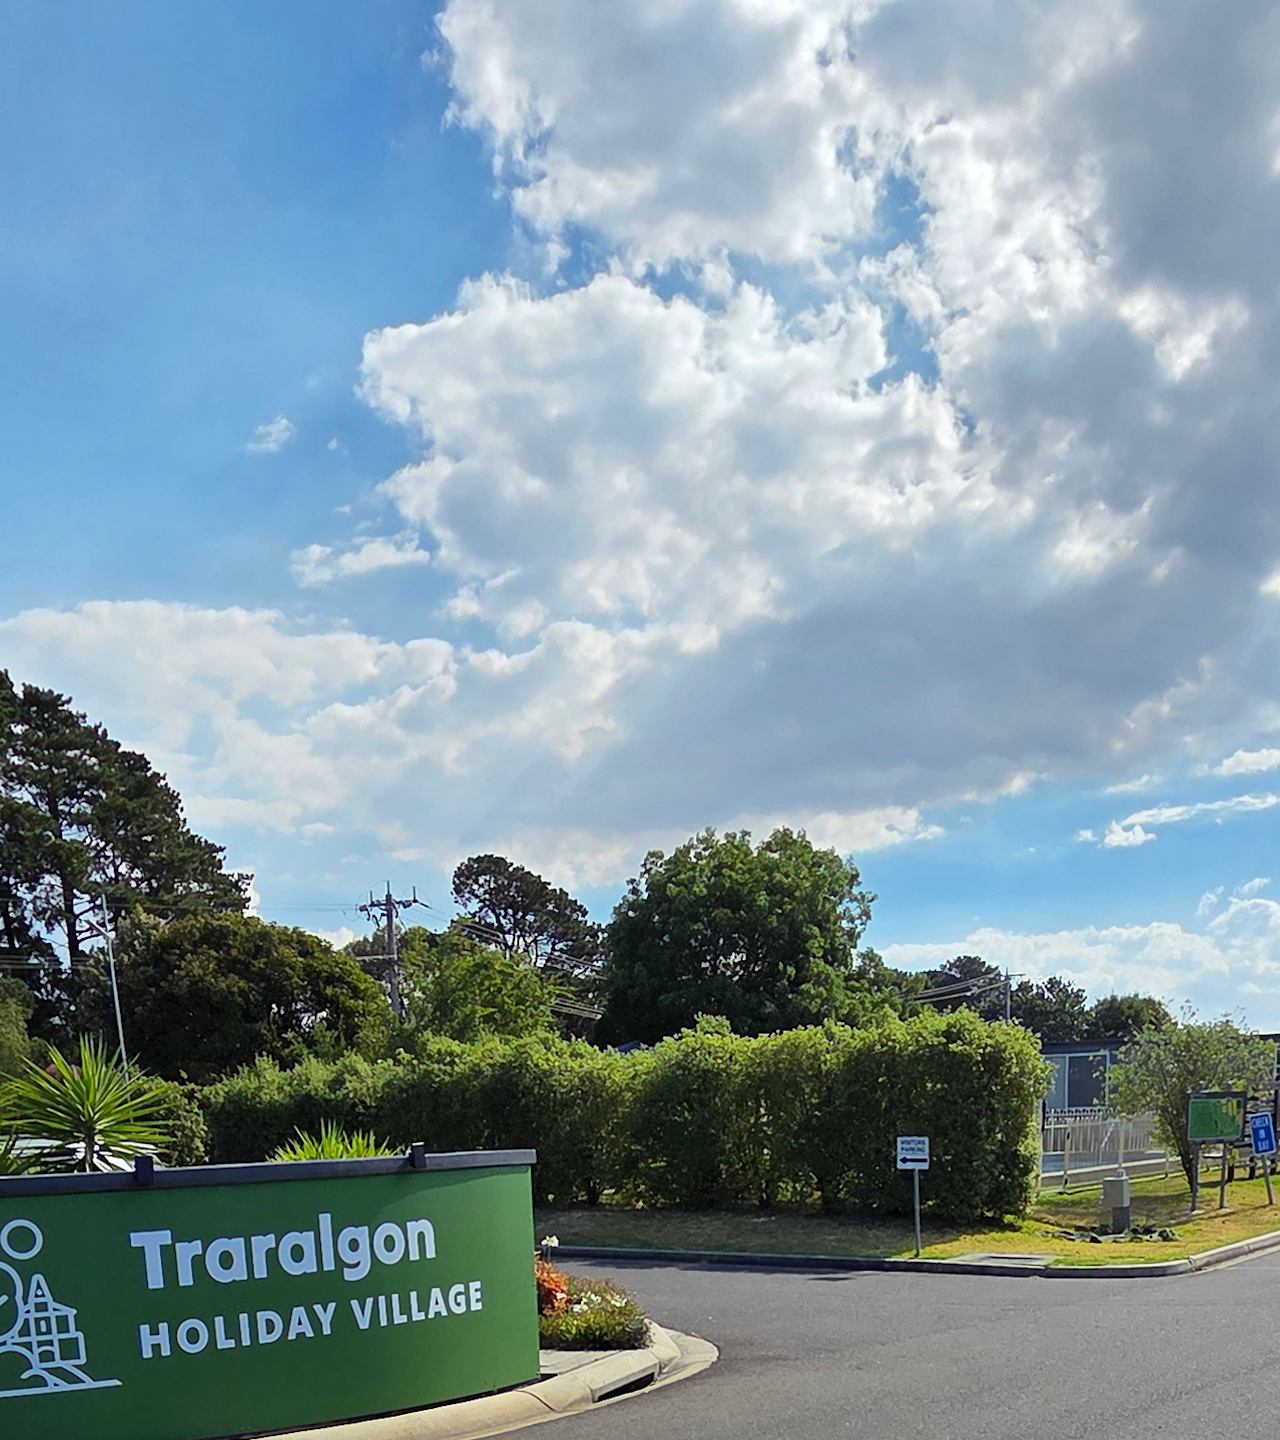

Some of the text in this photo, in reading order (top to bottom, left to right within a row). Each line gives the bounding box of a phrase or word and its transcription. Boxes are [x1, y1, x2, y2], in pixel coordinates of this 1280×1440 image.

[130, 1213, 436, 1289] Traralgon
[139, 1281, 483, 1358] HOLIDAY VILLAGE
